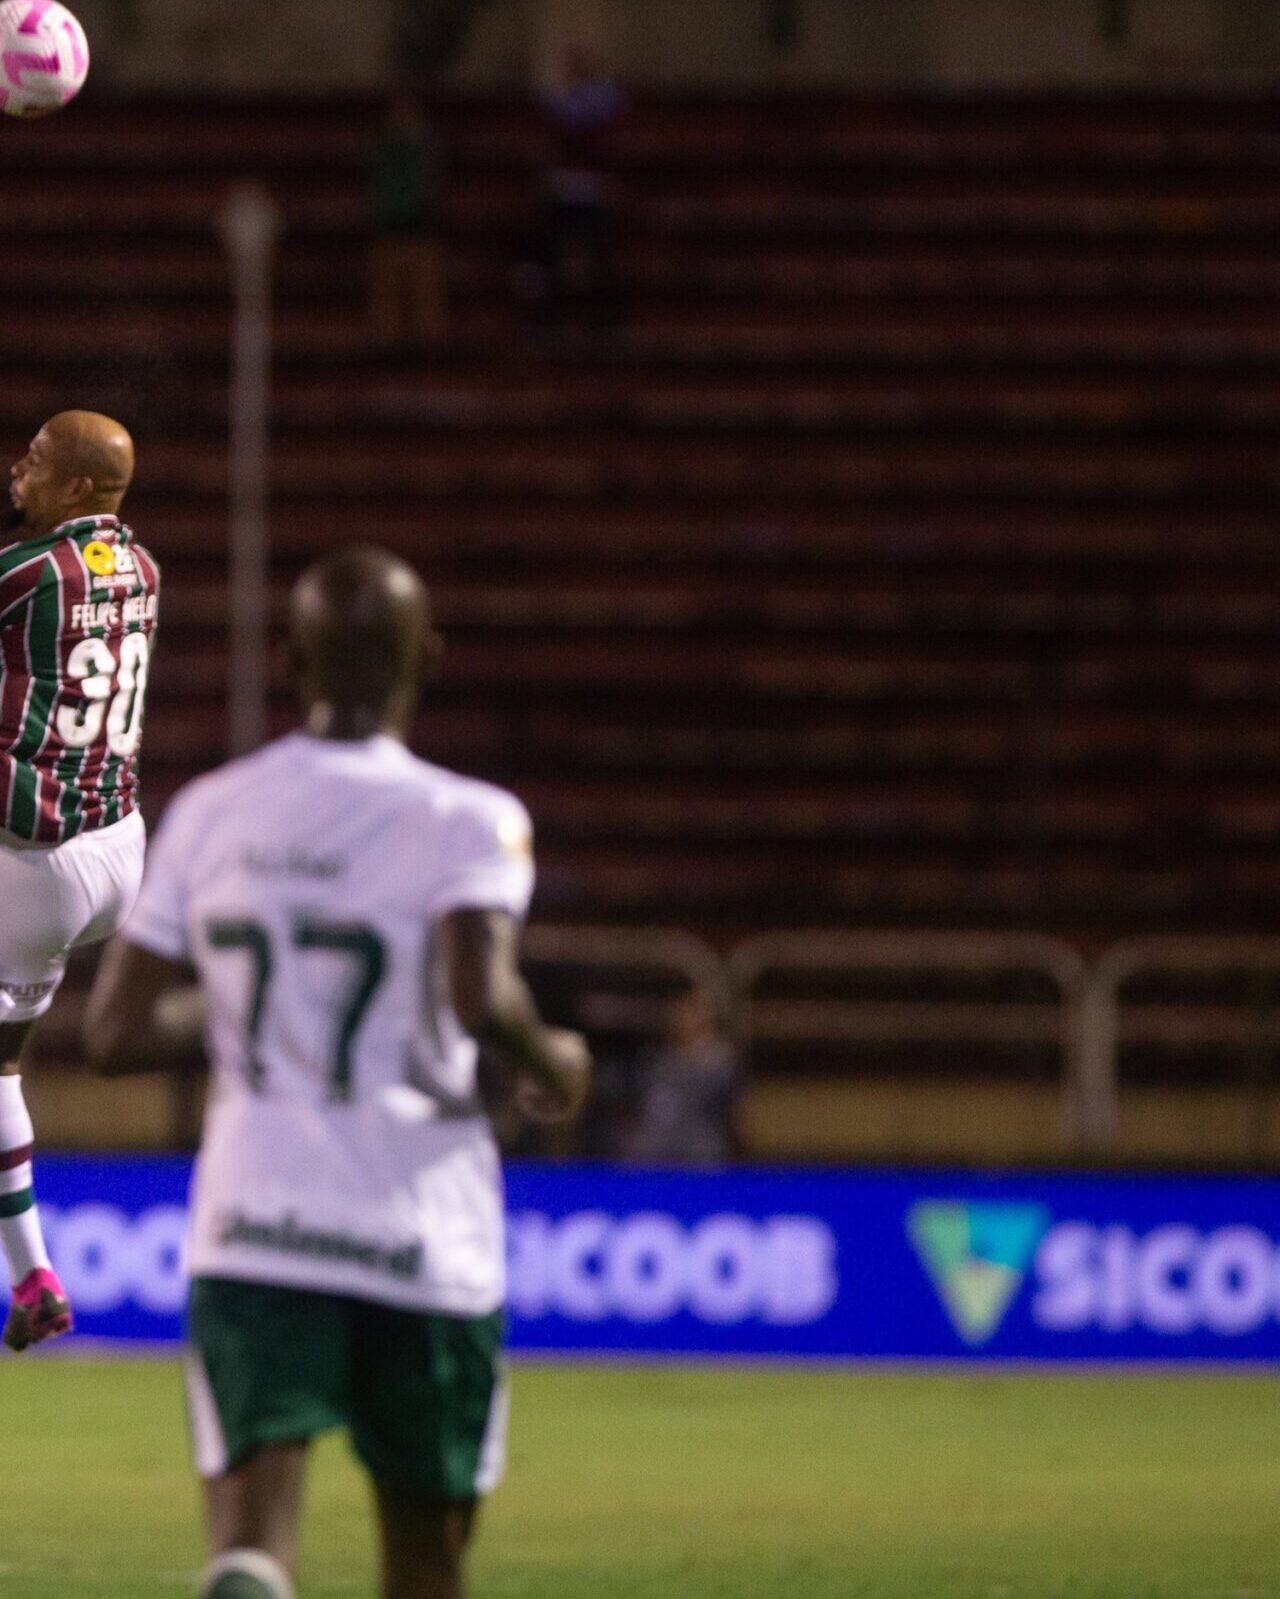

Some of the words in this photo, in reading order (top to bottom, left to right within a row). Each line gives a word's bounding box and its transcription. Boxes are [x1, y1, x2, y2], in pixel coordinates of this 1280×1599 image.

[71, 601, 119, 629] FELIPE
[56, 632, 148, 757] 30
[204, 909, 387, 1104] 77
[507, 1210, 838, 1326] ICOOB
[1030, 1219, 1280, 1336] SICO
